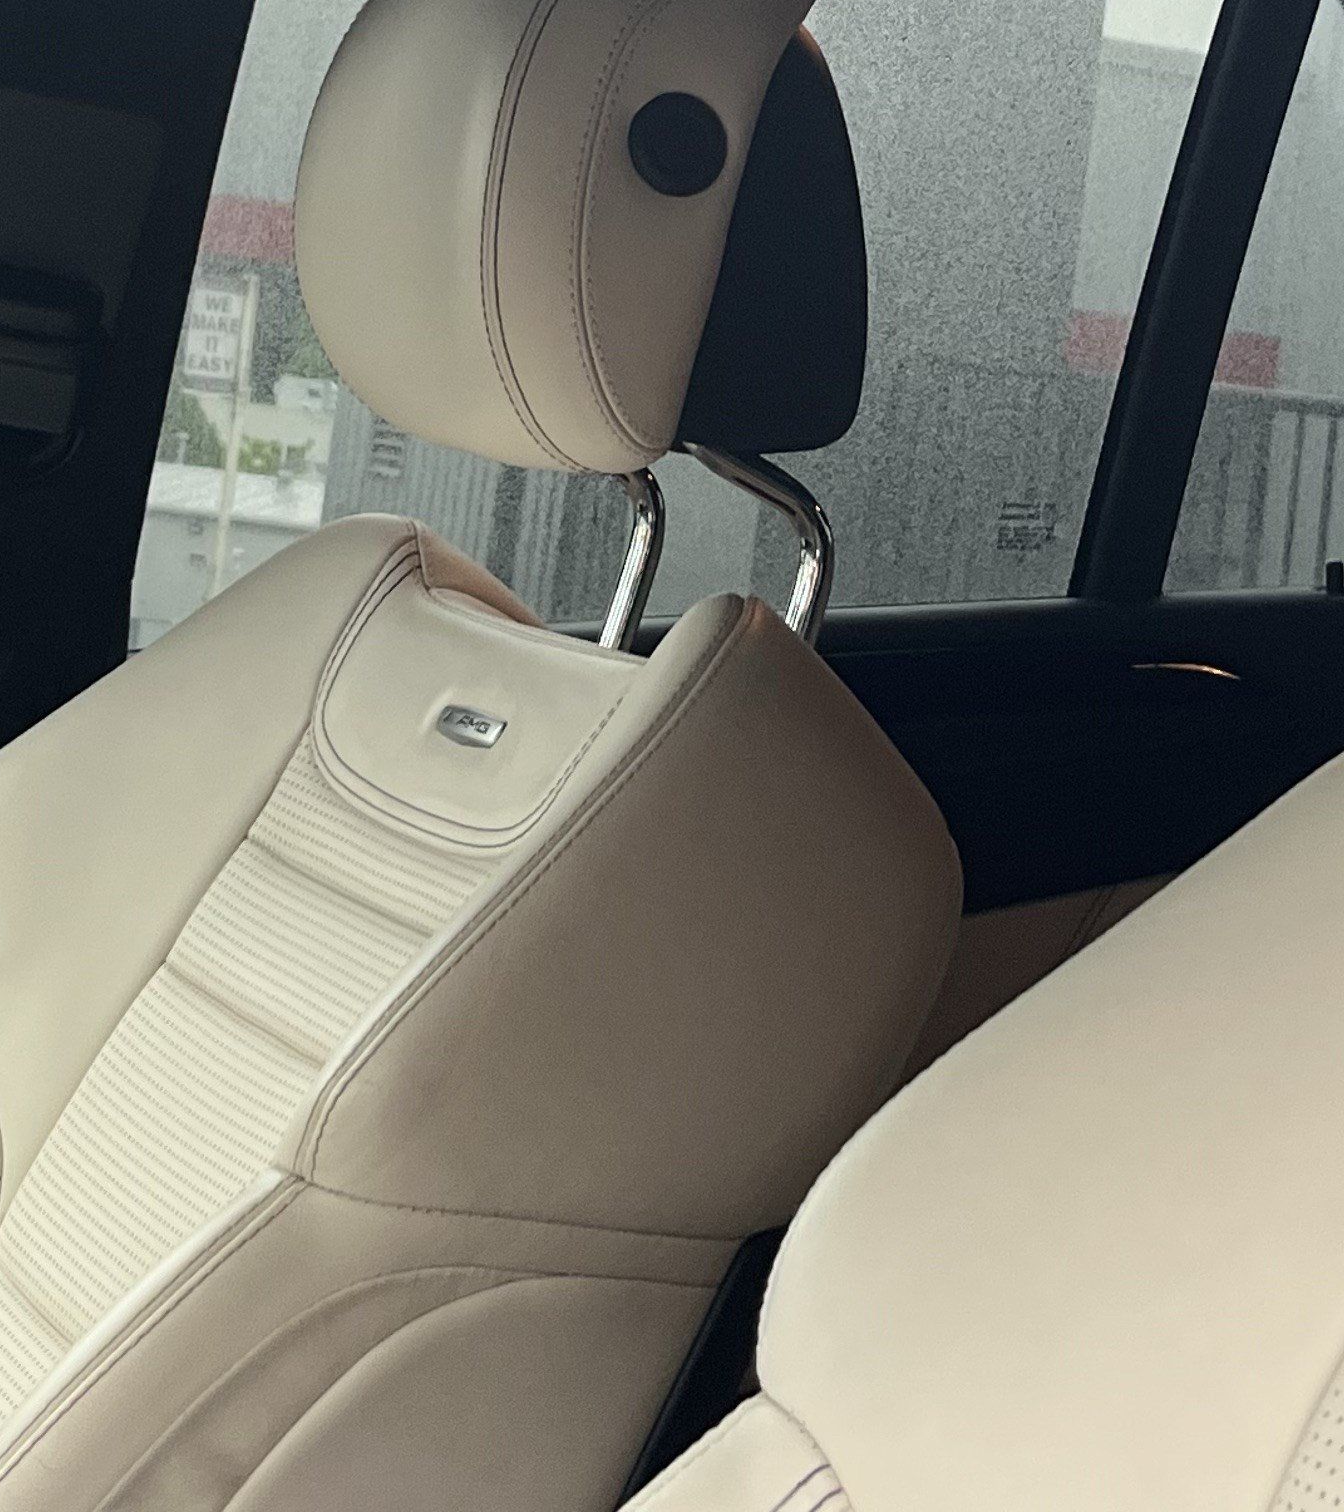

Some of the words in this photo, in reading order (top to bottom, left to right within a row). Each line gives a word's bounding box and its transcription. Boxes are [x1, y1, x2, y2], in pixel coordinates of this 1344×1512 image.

[205, 294, 232, 312] WE
[192, 313, 240, 334] MAKE
[205, 335, 219, 353] IT
[187, 354, 234, 373] EASY
